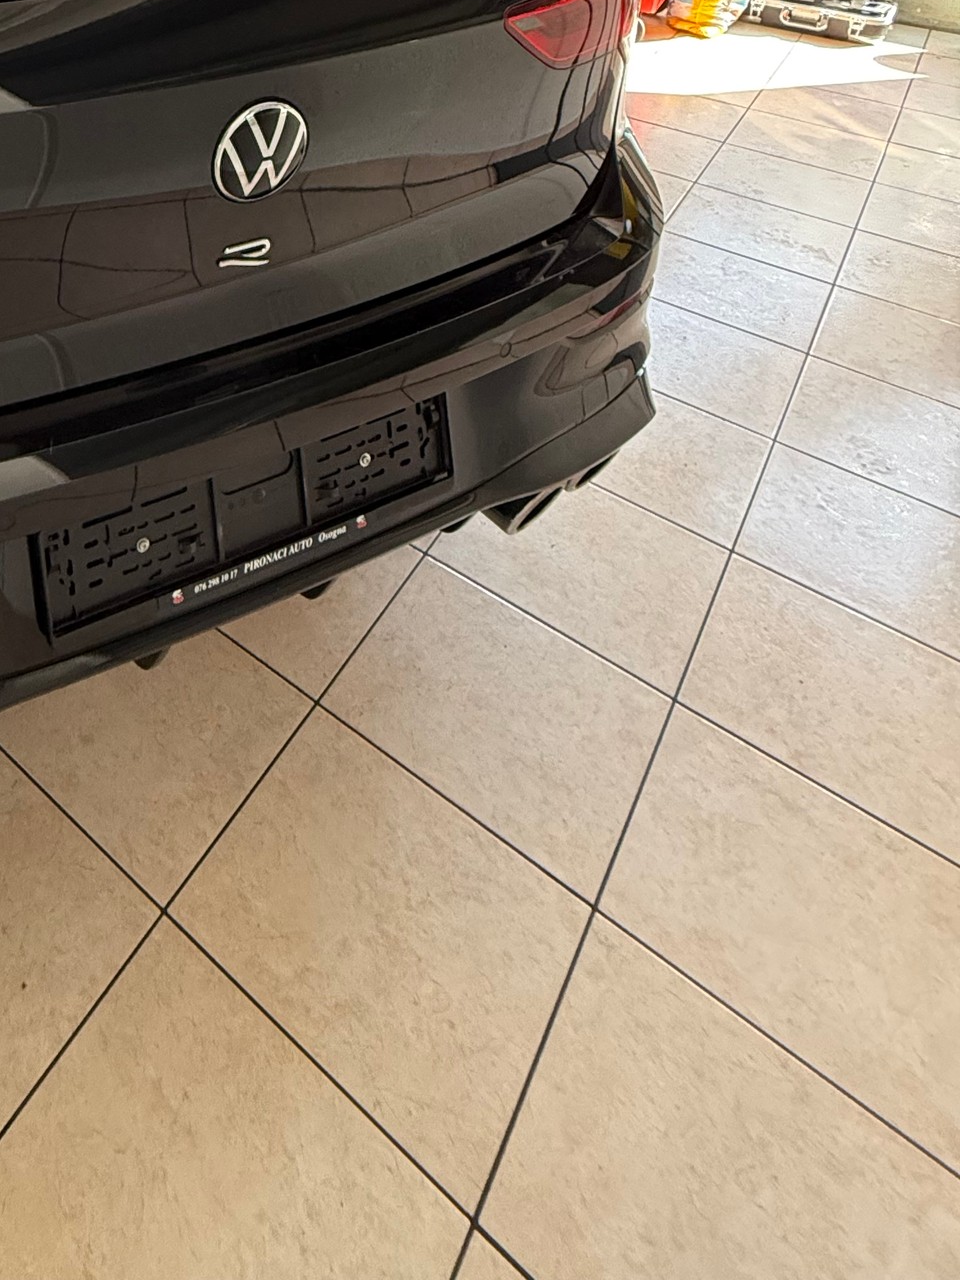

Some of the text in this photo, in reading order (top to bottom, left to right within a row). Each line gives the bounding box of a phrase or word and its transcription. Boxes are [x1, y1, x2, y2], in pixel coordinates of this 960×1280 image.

[193, 581, 208, 595] 076
[230, 568, 239, 580] 17
[243, 548, 287, 574] PIRONACI
[287, 537, 314, 557] AUTO
